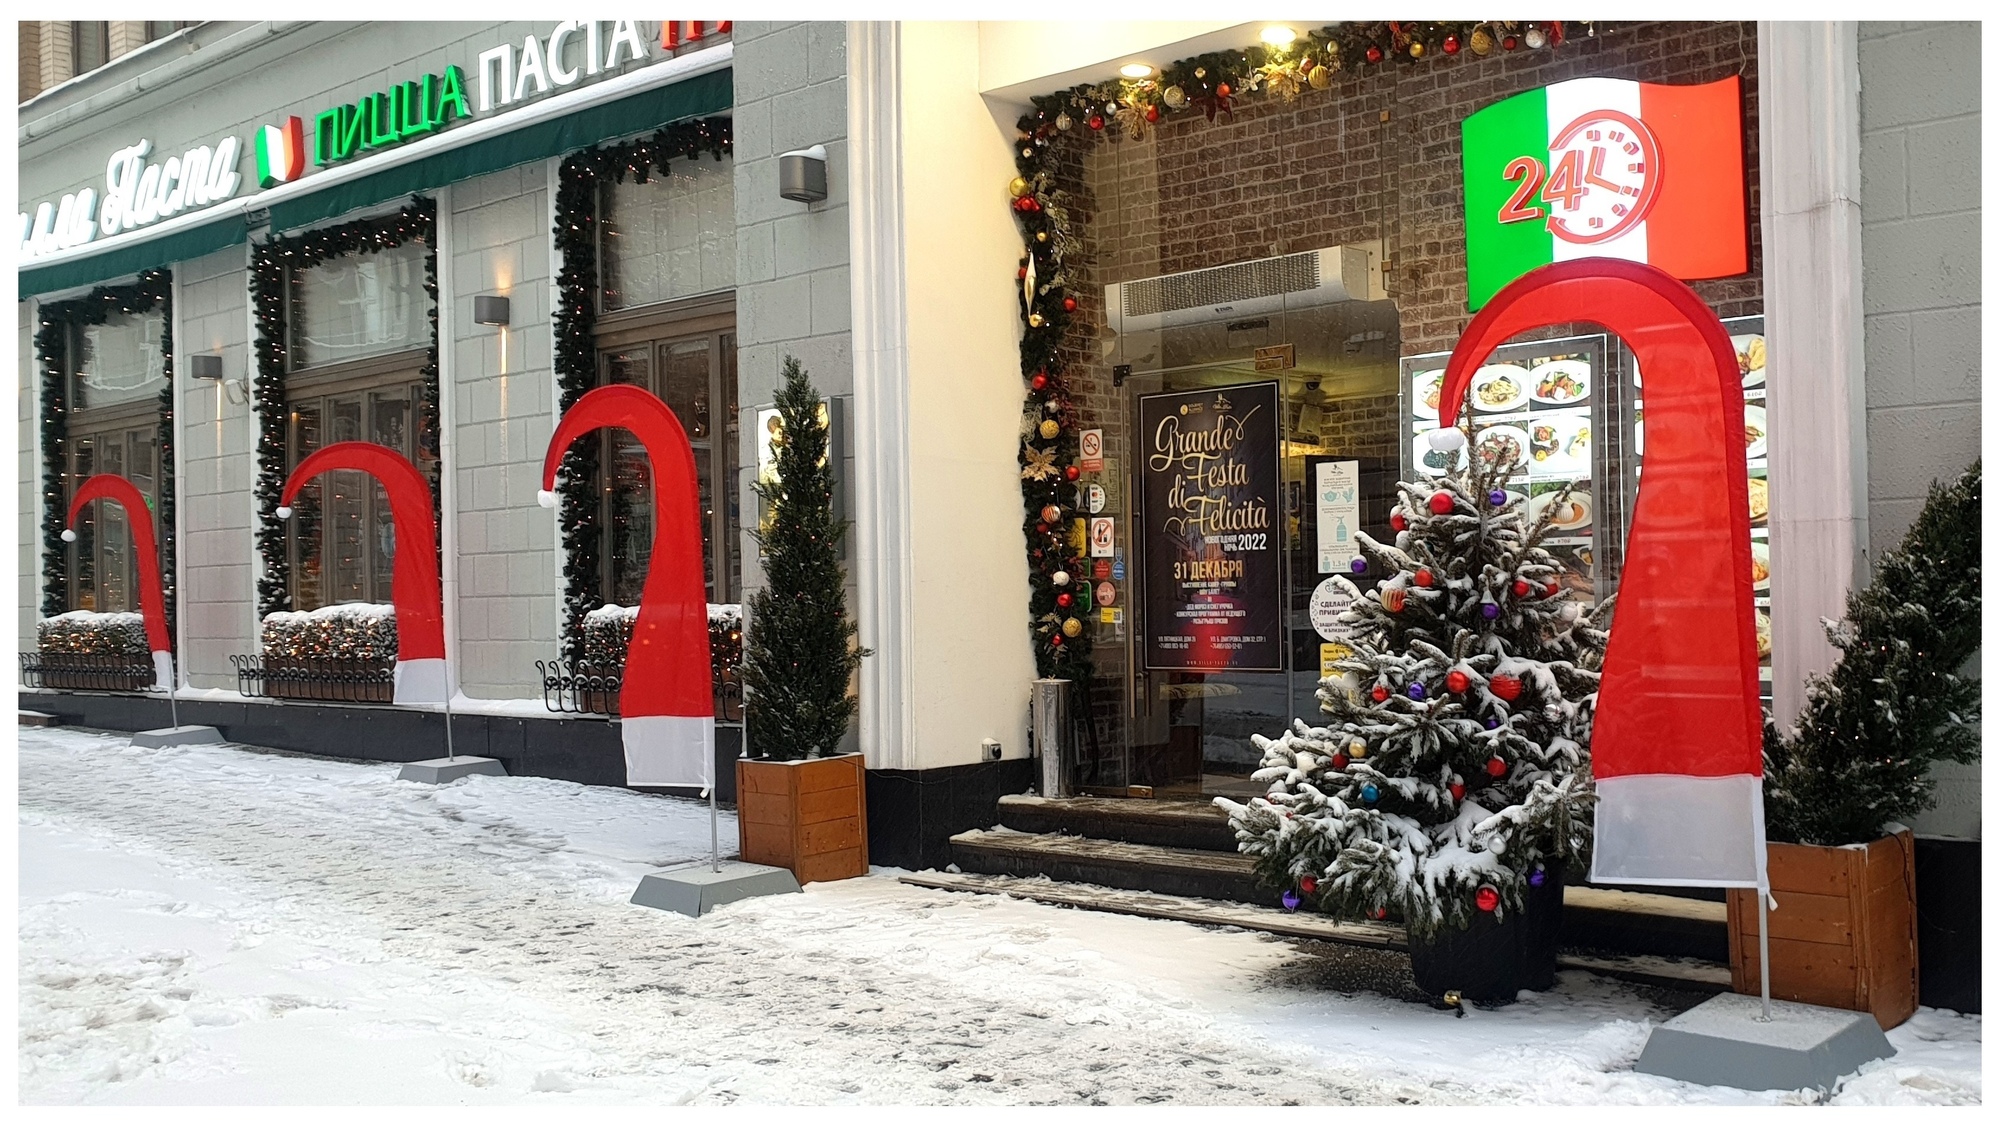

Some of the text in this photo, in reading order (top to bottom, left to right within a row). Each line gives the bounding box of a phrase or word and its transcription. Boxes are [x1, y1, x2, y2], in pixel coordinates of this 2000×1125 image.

[314, 21, 649, 166] ПИЦЦА ПАСТА
[18, 136, 243, 254] лла Паста
[1497, 150, 1584, 224] 24
[1150, 415, 1235, 471] Grande
[1169, 474, 1186, 508] di
[1183, 452, 1249, 492] Festa
[1184, 495, 1271, 535] Felicità
[1238, 533, 1267, 550] 2022
[1174, 560, 1243, 580] 31 ДЕКАБРЯ
[1320, 600, 1351, 608] СДЕЛАЙТ
